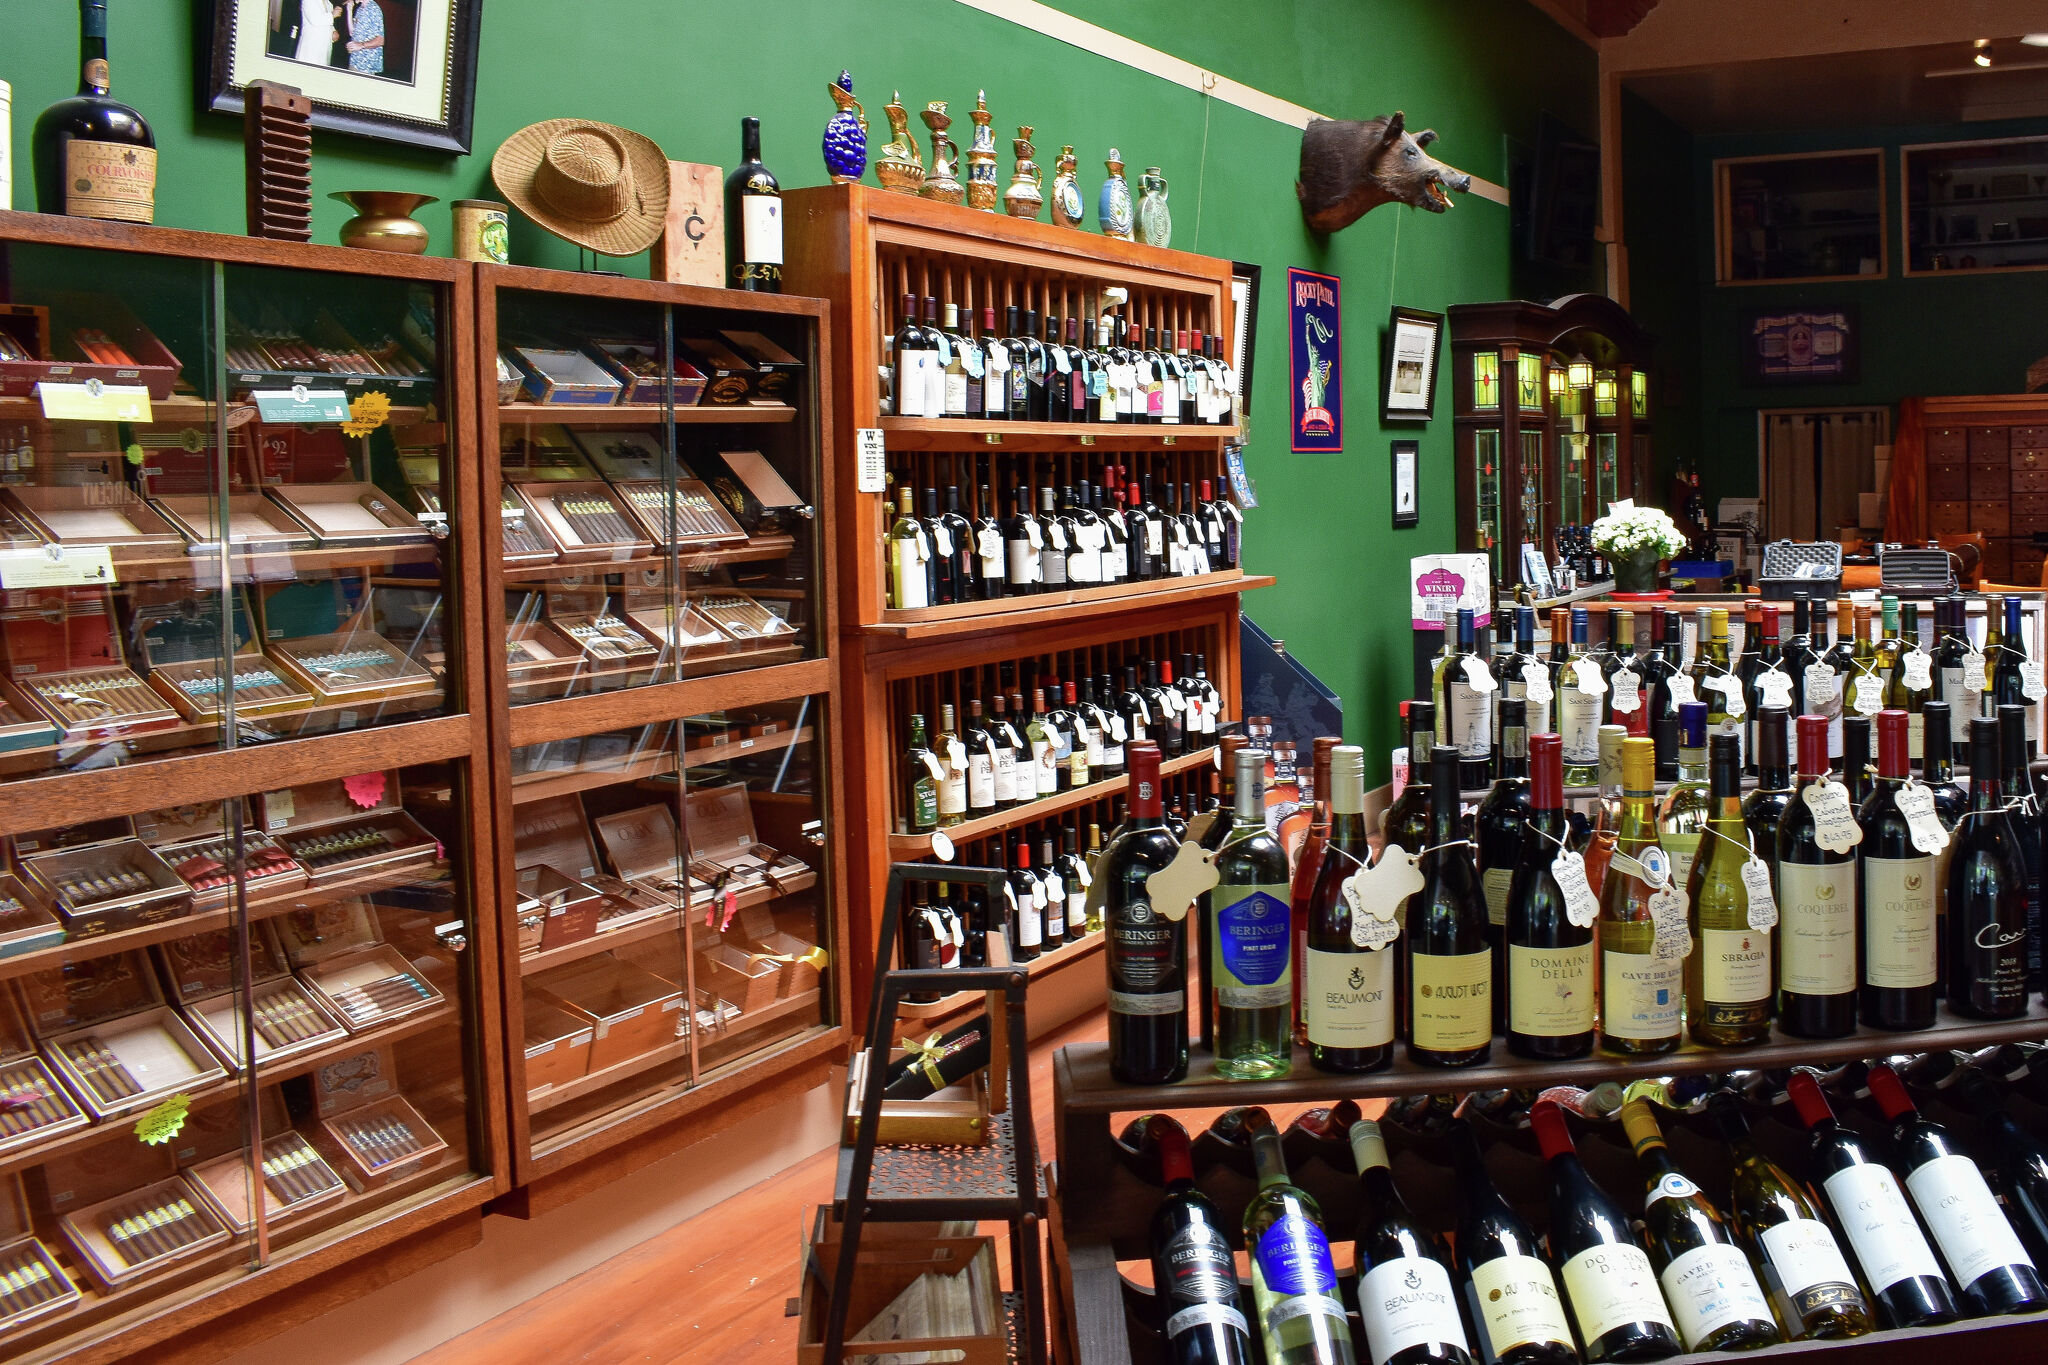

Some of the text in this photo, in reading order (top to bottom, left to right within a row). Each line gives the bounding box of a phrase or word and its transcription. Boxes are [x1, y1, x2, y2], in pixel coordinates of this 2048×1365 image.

[684, 215, 706, 241] C
[271, 439, 287, 455] 92
[1424, 584, 1457, 592] WINERY
[1113, 928, 1172, 940] BERINGER
[1229, 922, 1286, 936] BERINGER
[1721, 951, 1765, 963] SBRAGIA
[1542, 968, 1583, 979] DELLA
[1621, 972, 1651, 980] CAVE
[1653, 971, 1666, 979] DE
[1326, 989, 1385, 1004] BEAUMONT
[1435, 984, 1468, 999] AUGUST
[1171, 1248, 1230, 1263] BERIGER
[1267, 1241, 1326, 1257] BERIGER
